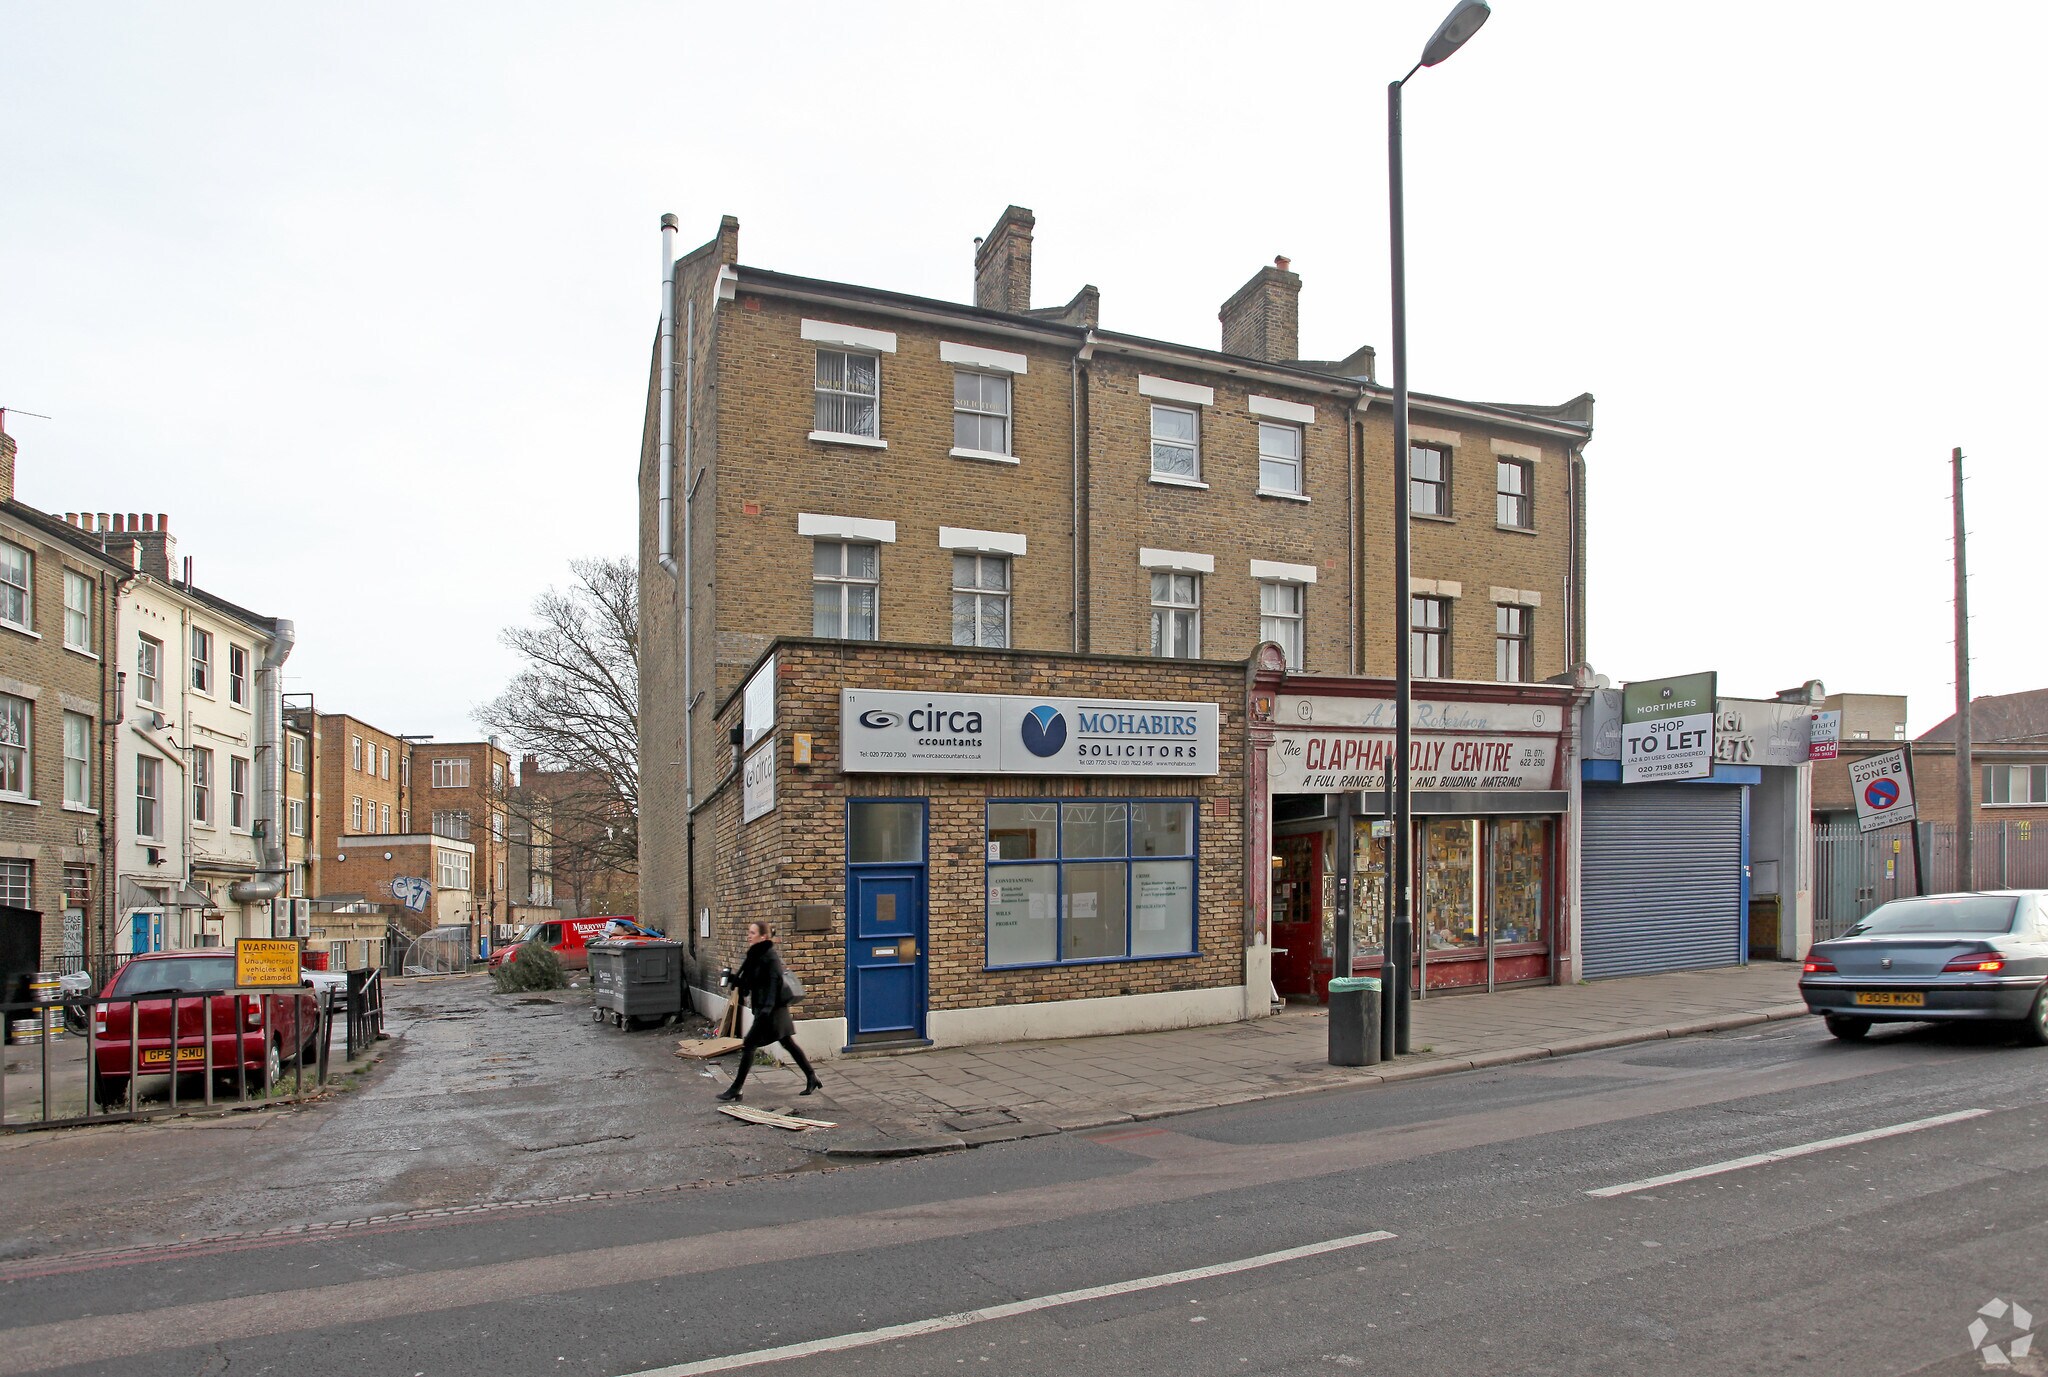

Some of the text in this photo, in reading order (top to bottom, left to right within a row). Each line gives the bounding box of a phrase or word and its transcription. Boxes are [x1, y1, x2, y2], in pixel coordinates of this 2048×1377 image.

[1302, 706, 1309, 715] 13
[1637, 699, 1697, 714] MORTIMERS
[909, 703, 982, 733] circa
[1078, 712, 1197, 736] MOHABIRS
[1536, 714, 1542, 723] 13
[1650, 720, 1684, 733] SHOP
[1811, 720, 1836, 729] rnard
[1628, 736, 1658, 755] TO
[1666, 730, 1707, 751] LET
[1814, 743, 1837, 753] sold
[1078, 744, 1197, 758] SOLICITORS
[1282, 739, 1301, 756] The
[1451, 742, 1513, 772] CENTRE
[1667, 750, 1706, 759] CONSIDERED)
[1520, 759, 1531, 767] 622
[1638, 765, 1653, 773] 020
[1853, 754, 1900, 772] Controlled
[755, 754, 773, 785] circa
[1855, 763, 1901, 783] ZONE C
[1303, 775, 1312, 787] A
[1314, 775, 1335, 787] FULL
[1339, 775, 1374, 787] RANGE
[1415, 776, 1437, 788] AND
[1440, 776, 1477, 788] BUILDING
[1481, 776, 1522, 788] MATERIALS
[573, 922, 605, 931] MERRYWE
[64, 941, 80, 949] RONT
[243, 943, 295, 951] WARNING
[150, 1048, 203, 1060] GP5 SMU
